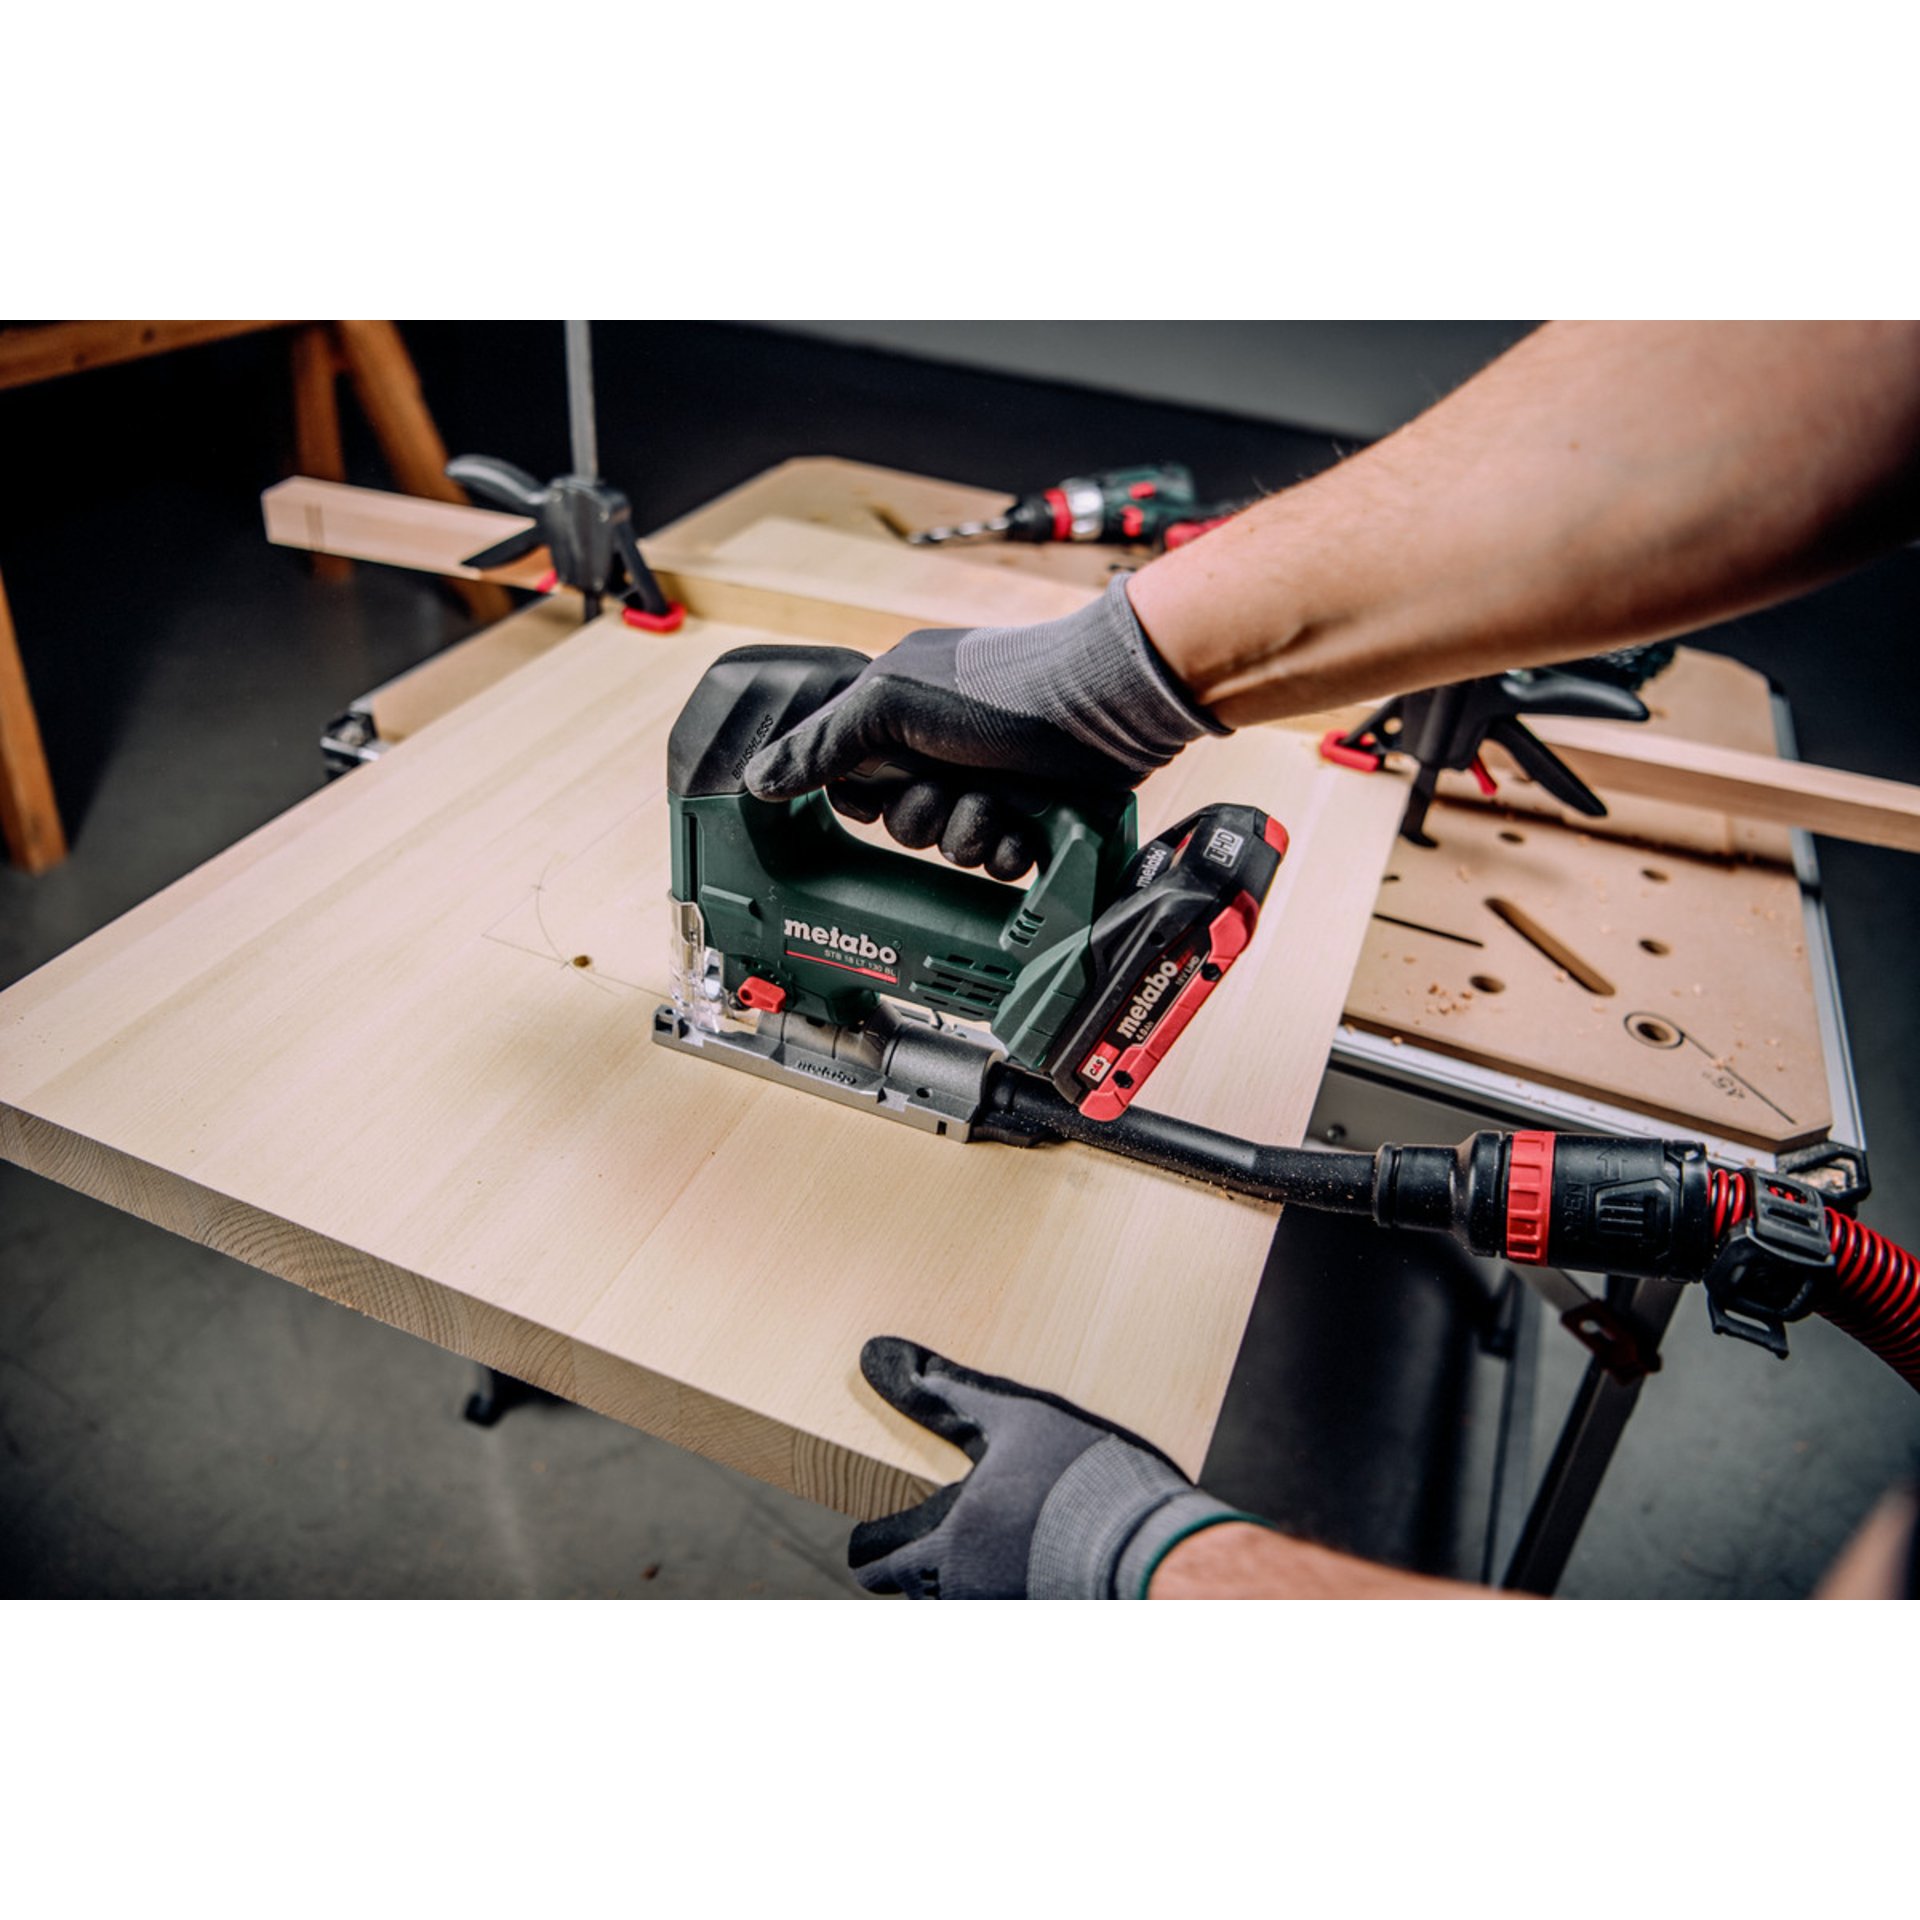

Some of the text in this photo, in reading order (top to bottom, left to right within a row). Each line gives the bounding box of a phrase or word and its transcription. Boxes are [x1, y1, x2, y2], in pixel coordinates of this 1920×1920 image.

[732, 714, 774, 780] BRUSHLESS
[1136, 848, 1168, 888] metabo
[784, 919, 898, 965] metabo
[1117, 961, 1179, 1039] metabo
